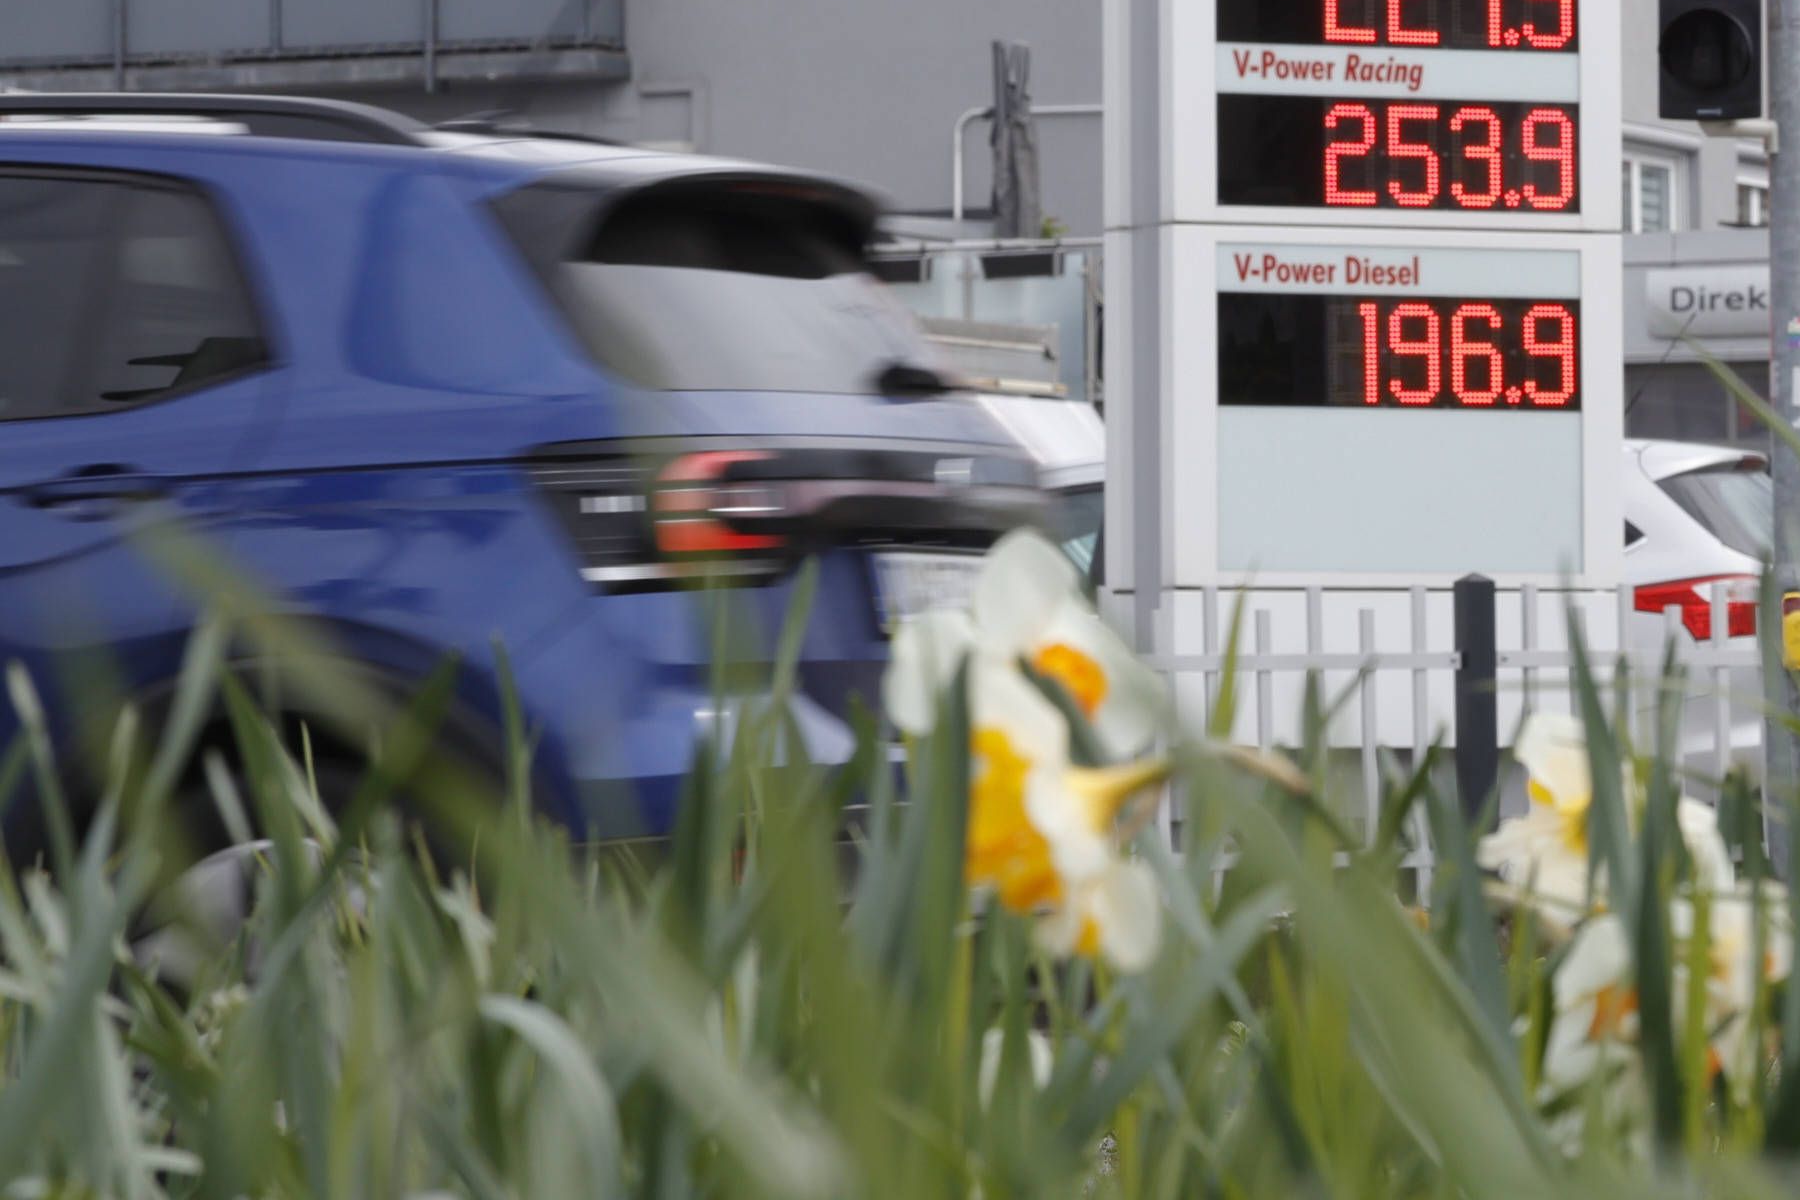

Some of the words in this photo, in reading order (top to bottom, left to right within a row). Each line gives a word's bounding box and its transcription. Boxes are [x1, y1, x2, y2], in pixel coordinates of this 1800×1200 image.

[1232, 49, 1335, 81] V-Power
[1344, 53, 1424, 91] Racing
[1324, 103, 1574, 209] 253.9
[1234, 254, 1336, 284] V-Power
[1344, 256, 1420, 286] Diesel
[1359, 302, 1575, 406] 196.9
